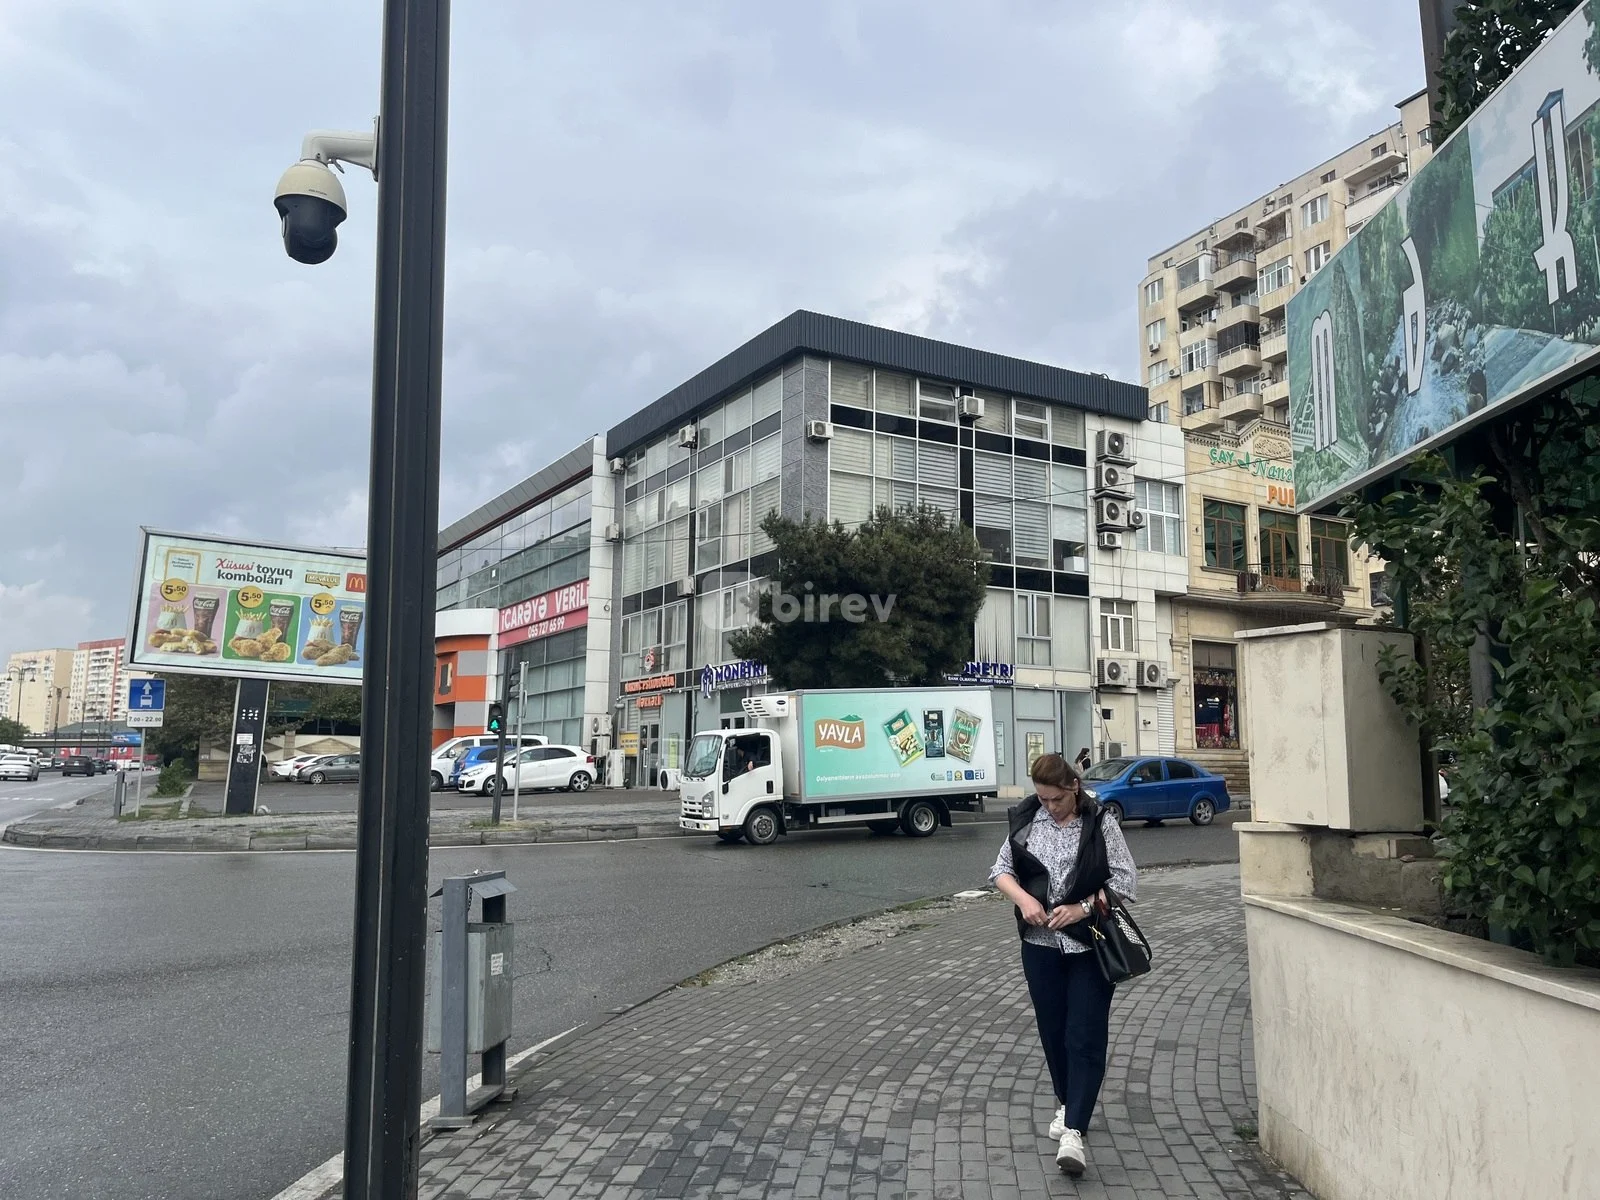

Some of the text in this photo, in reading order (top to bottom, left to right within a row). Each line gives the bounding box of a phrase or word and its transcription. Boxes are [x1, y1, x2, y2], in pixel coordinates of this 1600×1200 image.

[1209, 447, 1235, 464] ÇAY
[215, 557, 293, 579] Xüsusi toyuq
[539, 621, 548, 636] 727
[557, 616, 565, 630] 99
[818, 723, 862, 744] YAYLA
[975, 772, 985, 780] EU
